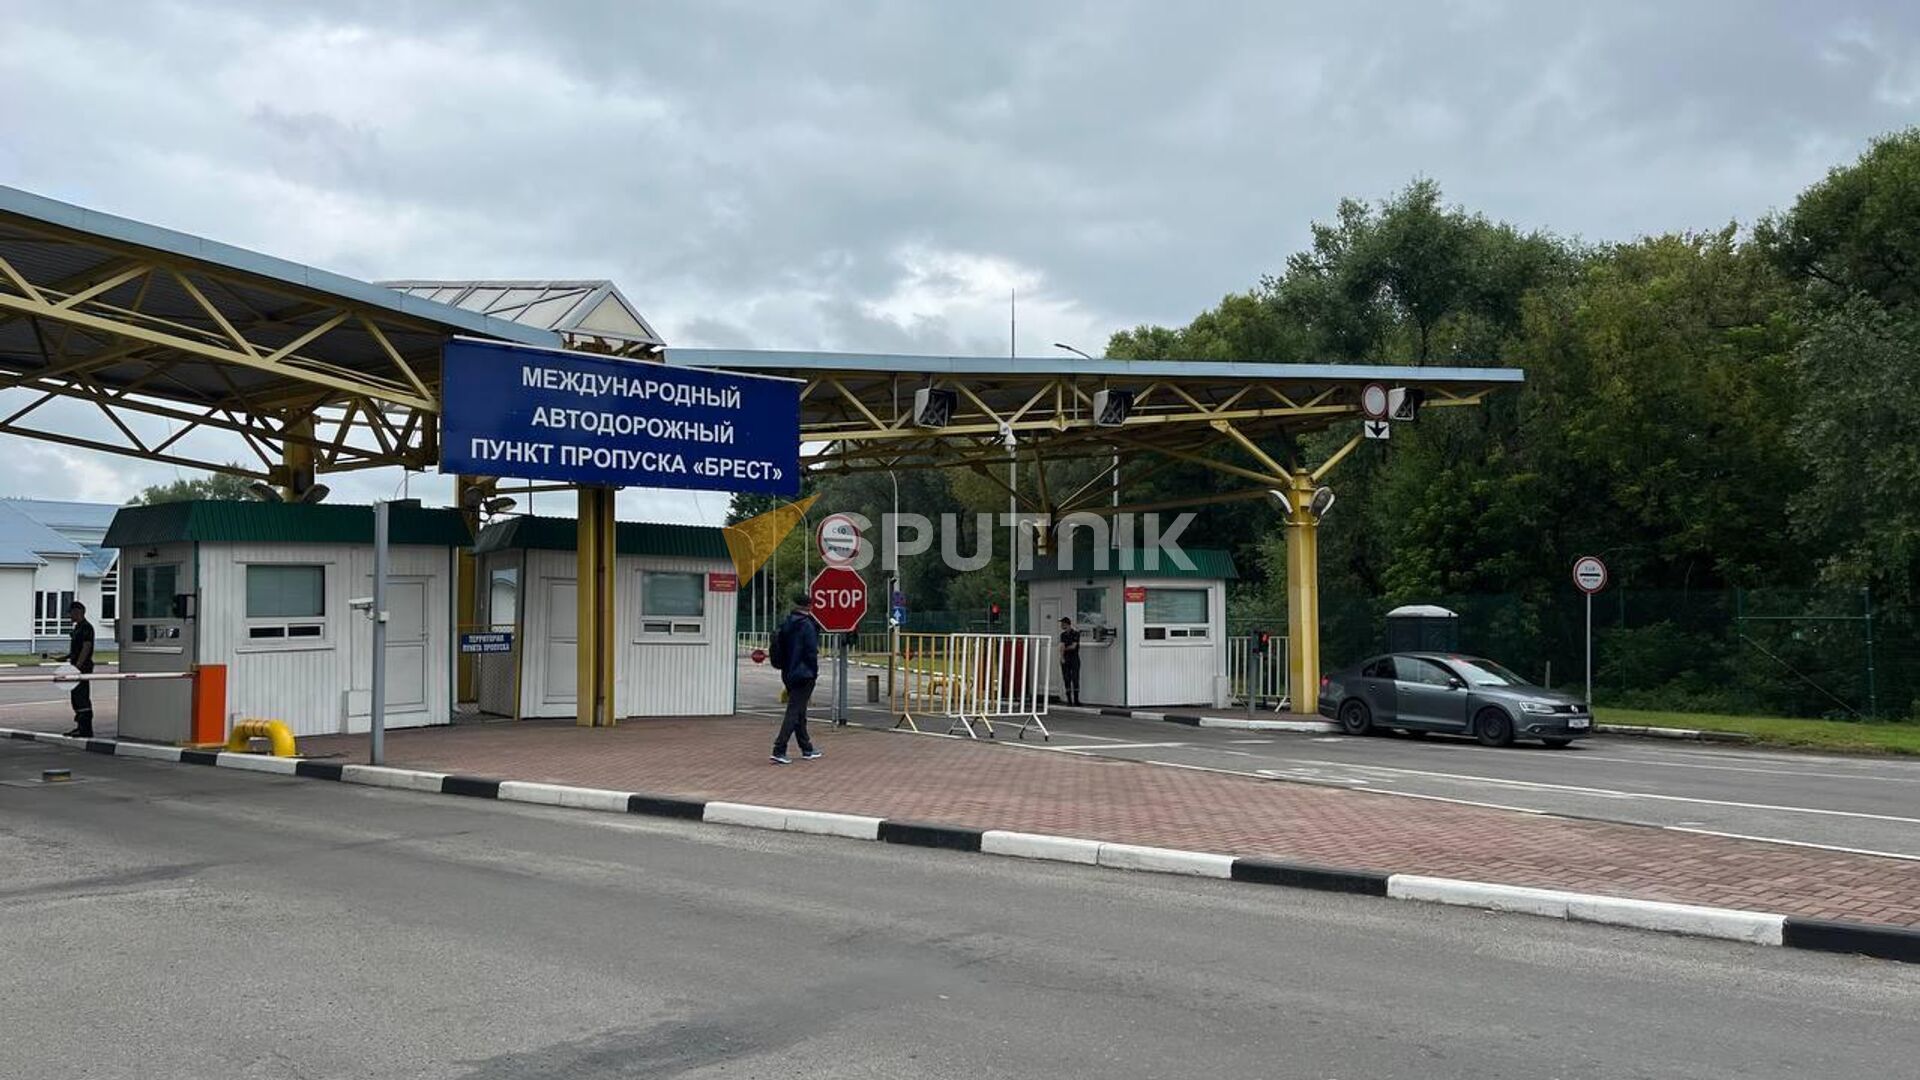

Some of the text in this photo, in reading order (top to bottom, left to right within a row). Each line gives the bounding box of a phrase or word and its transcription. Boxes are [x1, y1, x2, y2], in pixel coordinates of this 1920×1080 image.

[522, 366, 741, 409] МЕЖДУНАРОДНЫЙ
[531, 407, 734, 444] АВТОДОРОЖНЫЙ
[471, 438, 782, 481] ПУНКТ ПРОПУСКА «БРЕСТ»
[814, 589, 863, 609] STOP
